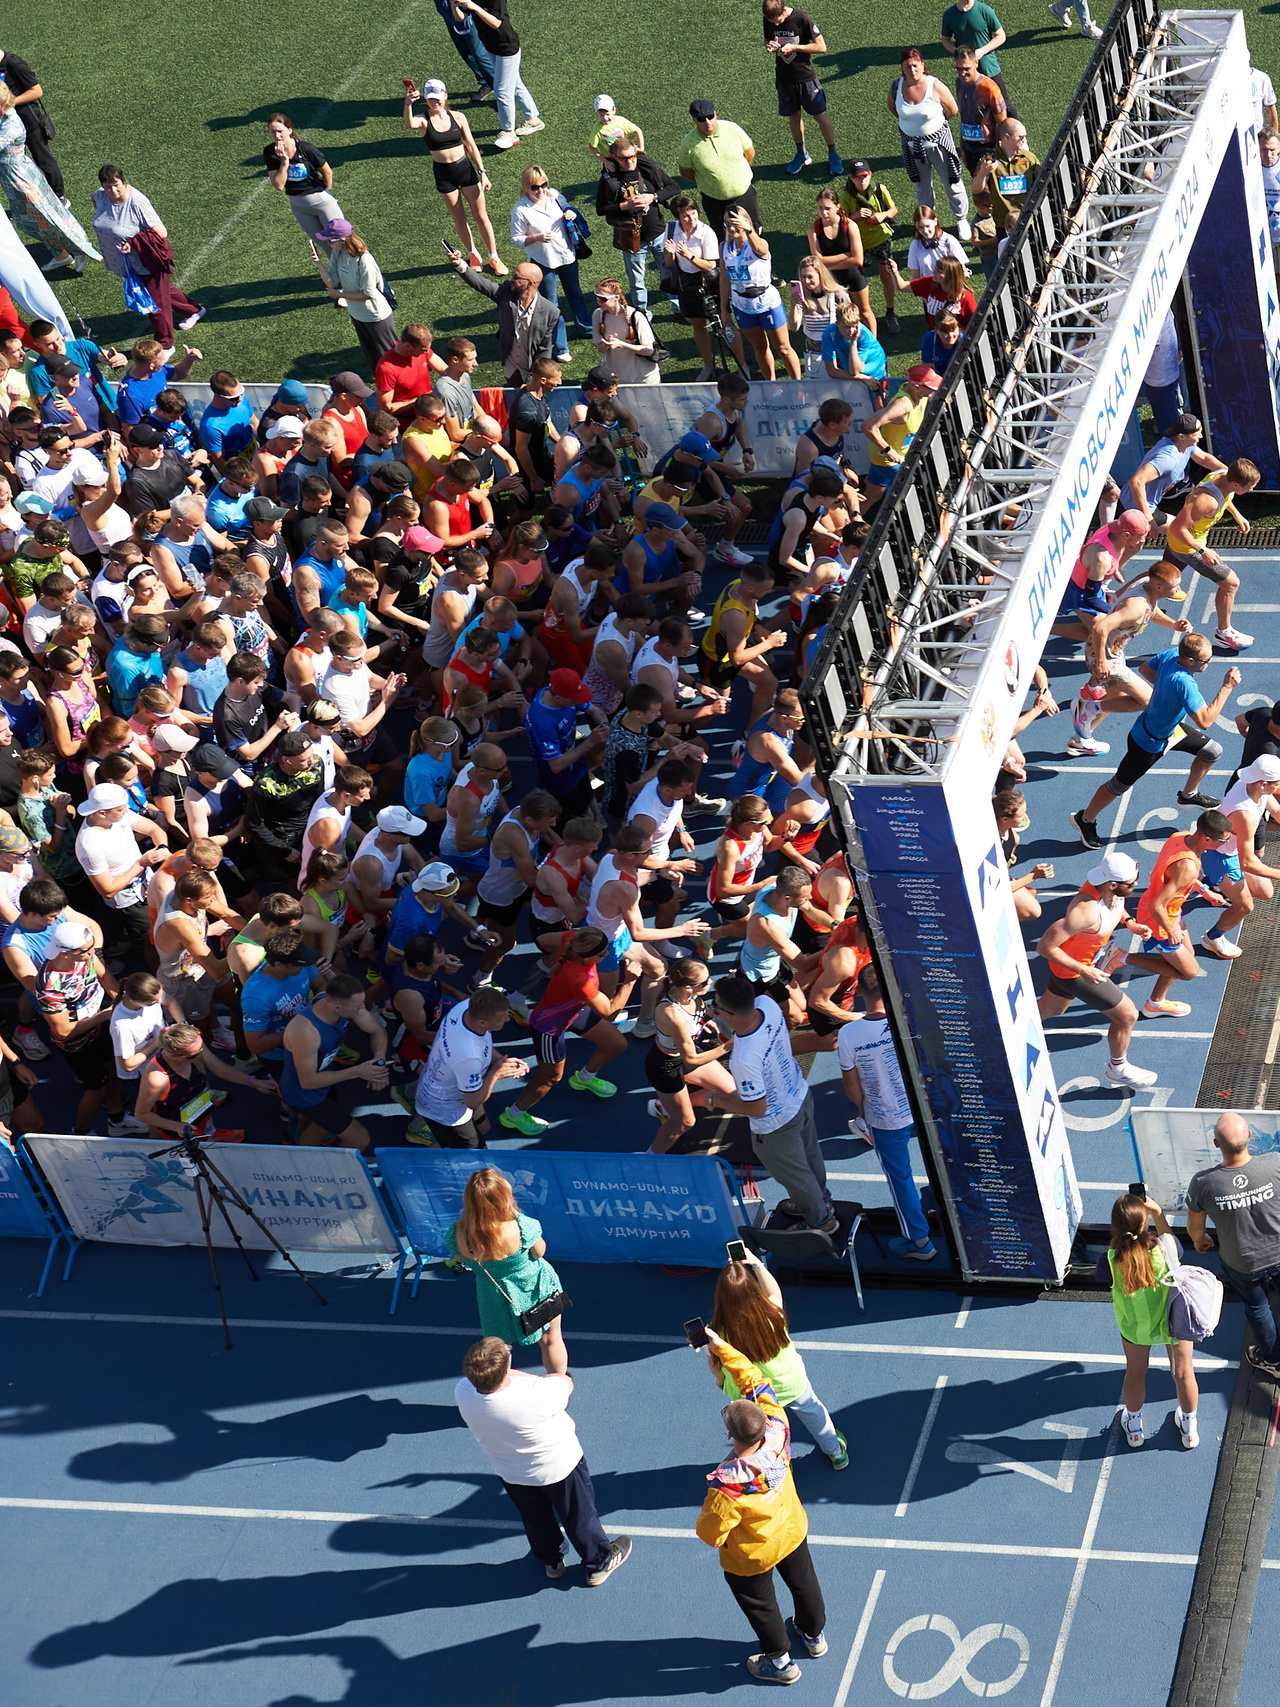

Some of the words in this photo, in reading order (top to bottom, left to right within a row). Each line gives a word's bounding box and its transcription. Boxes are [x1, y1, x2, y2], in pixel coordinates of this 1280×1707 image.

[728, 272, 748, 280] 156
[1028, 363, 1132, 639] ДИНАМОВСКАЯ
[1132, 262, 1168, 342] МИЛЯ
[1174, 164, 1200, 232] 2024
[755, 419, 866, 438] ДИНО
[252, 1173, 357, 1186] DINAMO-UDM.RU
[573, 1180, 690, 1195] DYNAMO-UDM.RU
[1214, 1182, 1274, 1203] RUSSIARUNNING
[1216, 1189, 1275, 1212] TIMING
[565, 1197, 718, 1225] ДИНАМО
[604, 1226, 692, 1241] УДМУРТИЯ
[945, 1422, 1088, 1493] 7
[883, 1613, 1031, 1700] 8
